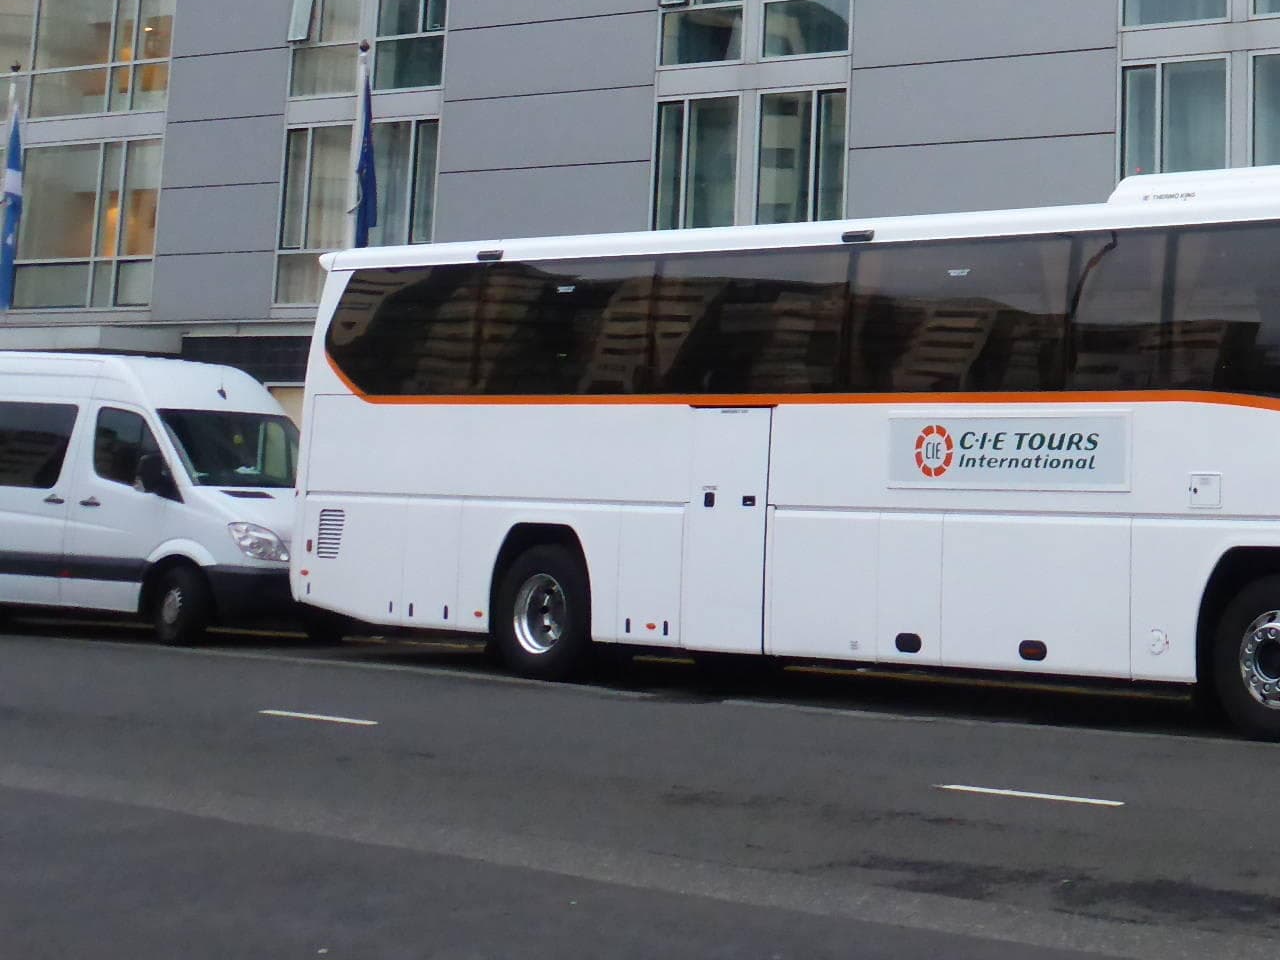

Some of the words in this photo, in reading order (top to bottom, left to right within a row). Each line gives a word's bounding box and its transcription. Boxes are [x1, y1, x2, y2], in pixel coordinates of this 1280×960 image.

[925, 441, 942, 460] CIE
[1014, 432, 1100, 452] TOURS
[959, 453, 1096, 470] International
